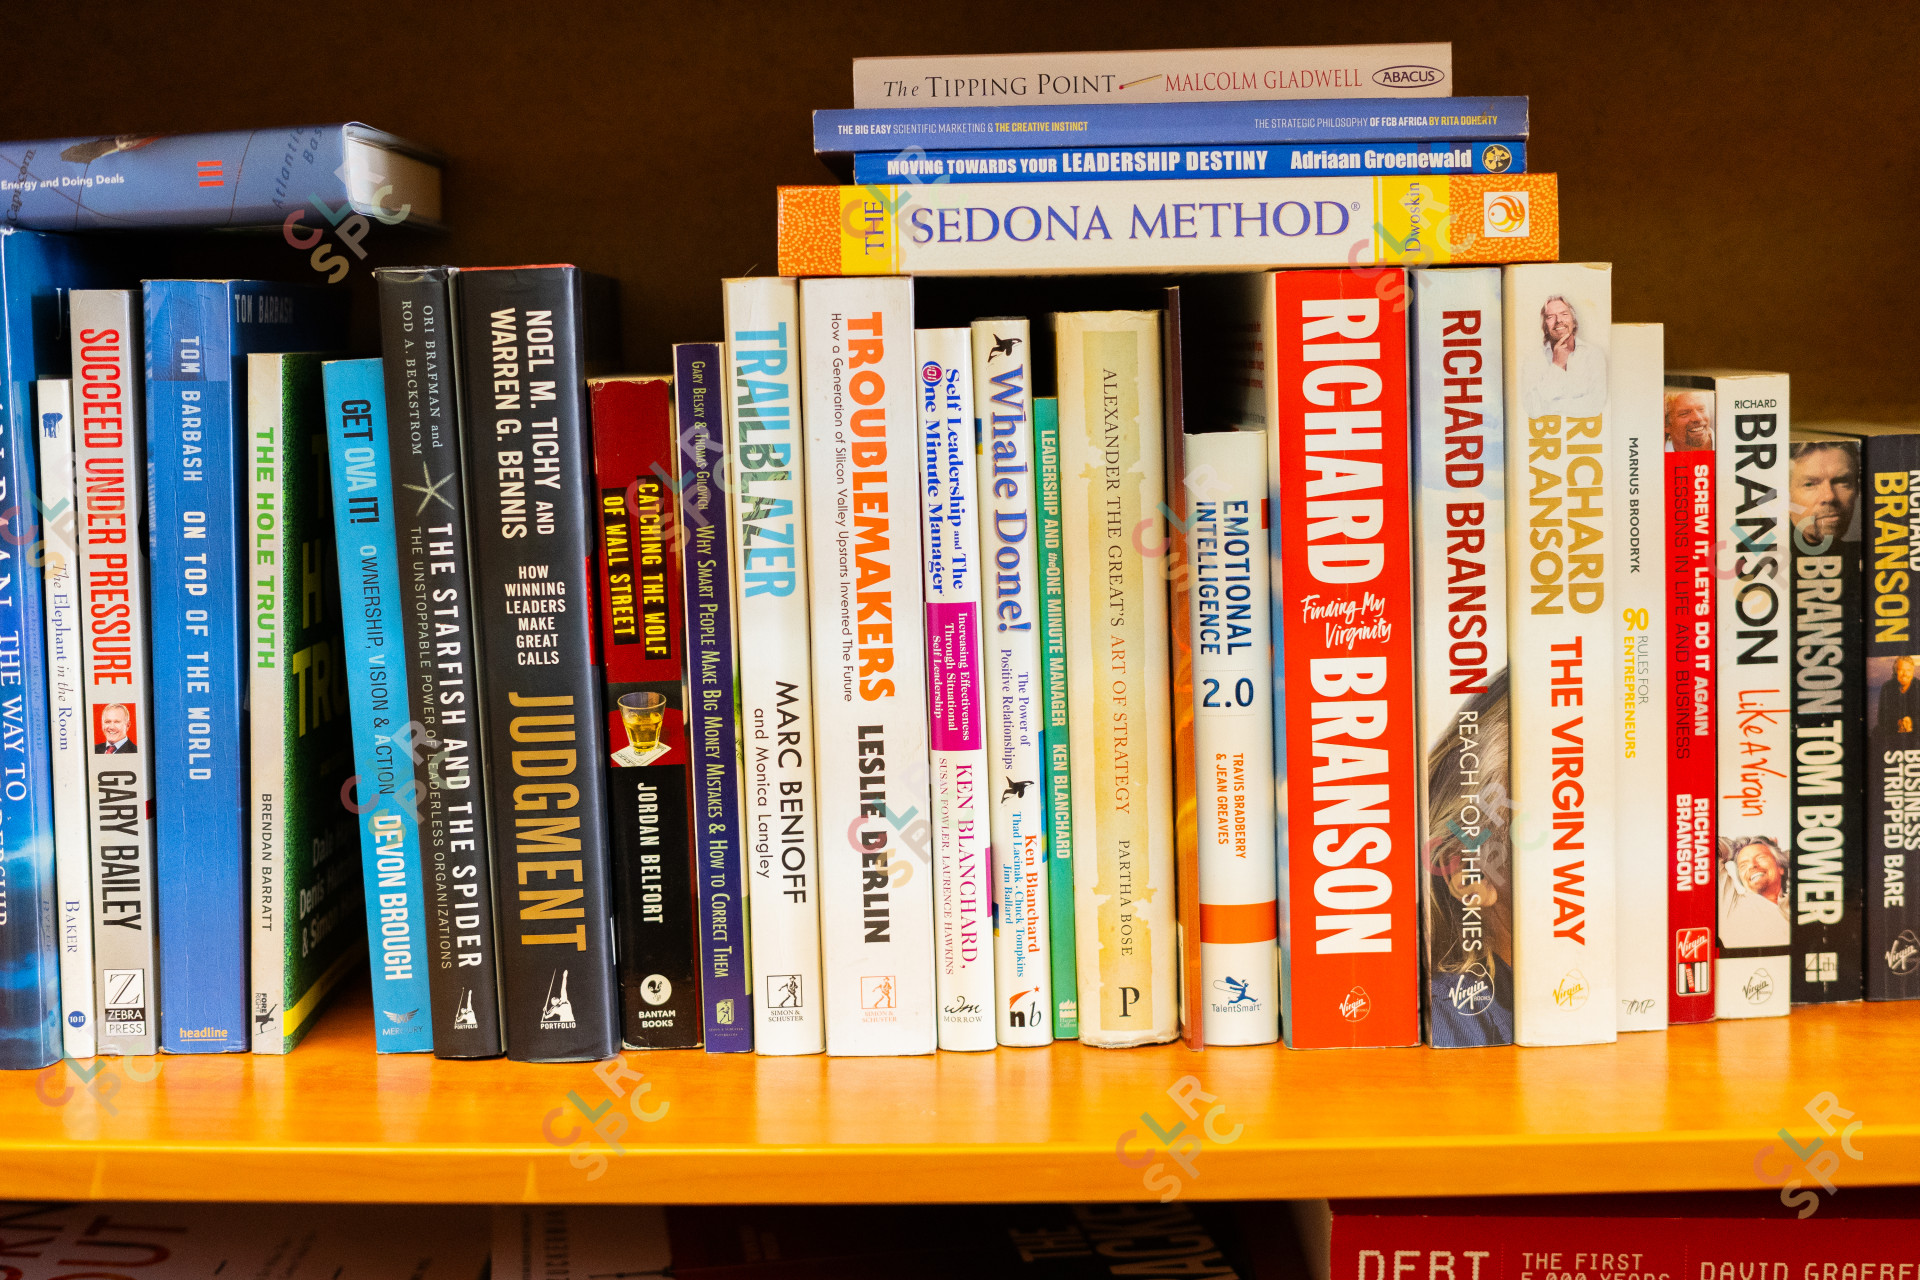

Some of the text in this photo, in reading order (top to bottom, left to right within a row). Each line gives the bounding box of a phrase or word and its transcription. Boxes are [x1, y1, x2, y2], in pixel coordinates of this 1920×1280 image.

[837, 121, 1088, 135] THE BIG EASY SCIENTIFIC MARKETING & THE CREATIVE INSTINCT
[884, 68, 1363, 98] The TIPPING POINT MALCOLM GLADWELL
[1254, 115, 1498, 129] THE STRATEGIC PHILOSOPHY OF FCB AFRICA BY RITA DOHERTY
[1382, 69, 1436, 84] ABACUS
[1, 173, 125, 192] Energy and Doing Deals
[864, 200, 885, 256] THE
[887, 150, 1268, 176] MOVING TOWARDS YOUR LEADERSHIP DESTINY
[911, 205, 1113, 244] SEDONA
[1290, 148, 1471, 170] Adriaan Groenewald
[1404, 181, 1420, 254] Dwoskin
[180, 335, 204, 482] TOM BARBASH
[342, 399, 380, 524] GET OVA IT!
[490, 307, 529, 540] WARREN G. BENNIS
[525, 309, 562, 536] NOEL M. TICHY AND
[735, 321, 797, 598] TRAILBLAZER
[944, 368, 967, 590] Self Leadership and The
[1103, 368, 1121, 492] ALEXANDER
[1302, 298, 1385, 584] RICHARD
[79, 329, 133, 686] SUCCEED UNDER PRESSURE
[256, 427, 276, 669] THE HOLE TRUTH
[603, 495, 636, 636] OF WALL STREET
[637, 483, 667, 656] CATCHING THE WOLF
[847, 311, 896, 702] TROUBLEMAKERS
[989, 364, 1032, 633] Whale Done!
[1107, 496, 1122, 540] THE
[1442, 309, 1488, 695] RICHARD BRANSON
[1527, 414, 1564, 616] BRANSON
[1565, 413, 1605, 615] RICHARD
[1628, 437, 1641, 575] MARNUS BROODRYK
[1735, 413, 1779, 666] BRANSON
[1874, 471, 1909, 643] BRANSON
[183, 509, 212, 780] ON TOP OF THE WORLD
[1196, 501, 1221, 655] INTELLIGENCE
[1223, 500, 1252, 655] EMOTIONAL
[1623, 607, 1649, 631] 90
[1796, 555, 1844, 715] BRANSON
[51, 563, 73, 751] The Elephant in the Room
[1110, 634, 1126, 675] ART
[1112, 680, 1127, 707] OF
[1202, 677, 1254, 708] 2.0
[1623, 635, 1637, 760] ENTREPRENEURS
[1637, 634, 1649, 704] RULES FOR
[428, 523, 483, 968] THE STARFISH AND THE SPIDER
[776, 680, 807, 904] MARC BENIOFF
[1053, 743, 1071, 860] KEN BLANCHARD
[1112, 712, 1130, 816] STRATEGY
[1309, 656, 1393, 955] BRANSON
[1551, 636, 1585, 946] THE VIRGIN WAY
[98, 769, 142, 931] GARY BAILEY
[260, 792, 273, 932] BRENDAN BARRATT
[508, 691, 587, 952] JUDGMENT
[637, 782, 664, 924] JORDAN BELFORT
[857, 724, 890, 944] LESLIE BERLIN
[955, 764, 979, 970] KEN BLANCHARD,
[1458, 711, 1482, 952] REACH FOR THE SKIES
[1676, 793, 1693, 892] BRANSON
[1693, 797, 1710, 886] RICHARD
[1796, 719, 1844, 926] TOM BOWER
[1883, 750, 1904, 909] STRIPPED BARE
[374, 814, 413, 981] DEVON BROUGH
[1118, 839, 1133, 957] PARTHA BOSE
[179, 1027, 229, 1038] headline
[638, 1010, 676, 1018] BANTAM
[641, 1019, 675, 1028] BOOKS
[1522, 1252, 1644, 1272] THE FIRST
